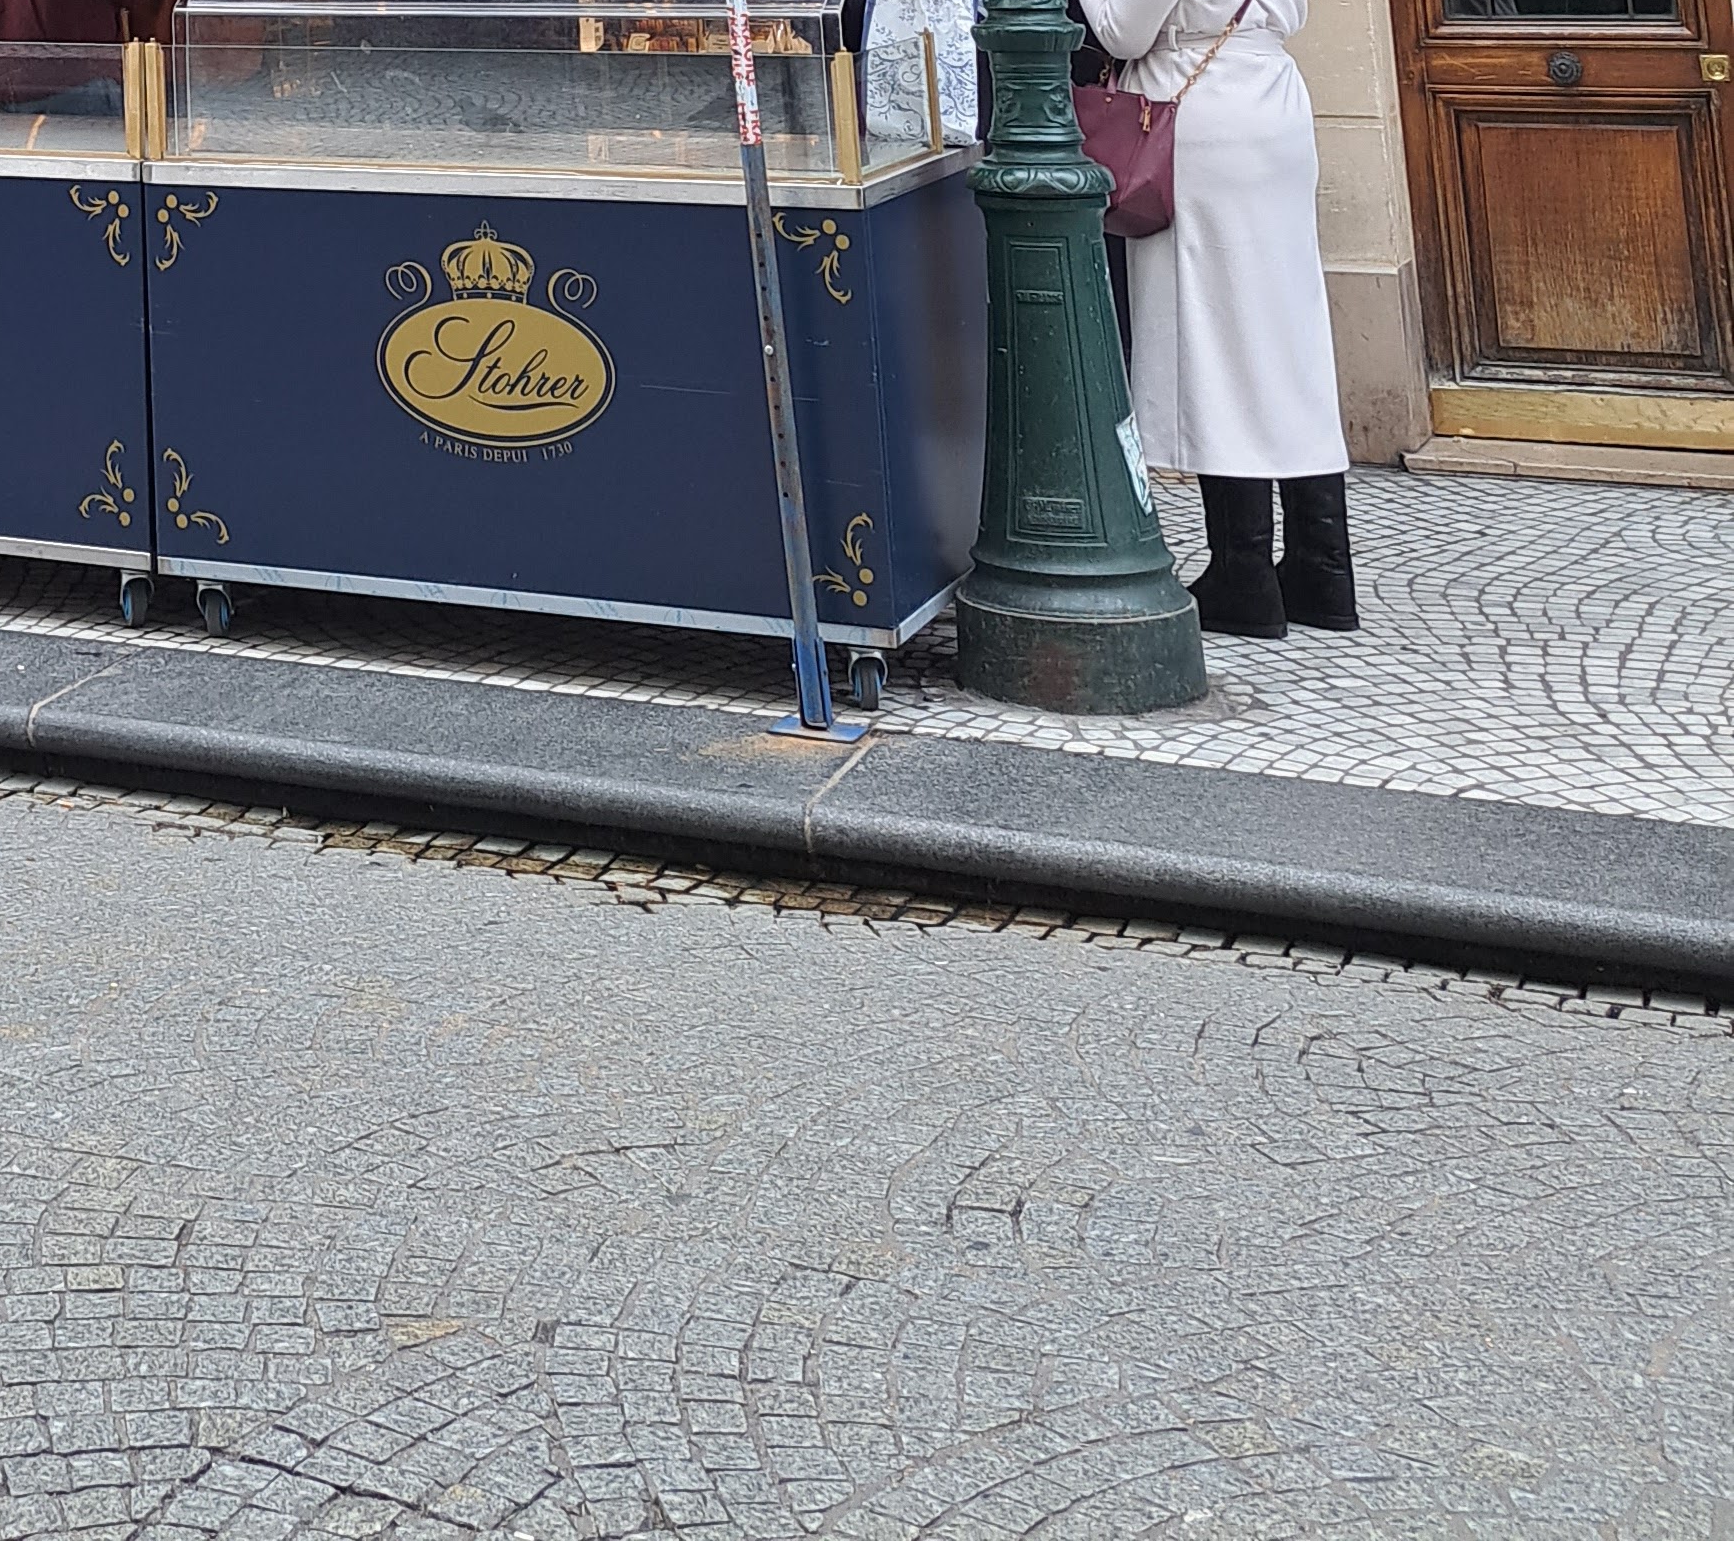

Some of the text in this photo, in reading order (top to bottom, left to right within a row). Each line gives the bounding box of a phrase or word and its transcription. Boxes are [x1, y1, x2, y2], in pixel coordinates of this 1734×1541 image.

[403, 315, 590, 405] Stohrer
[434, 435, 478, 460] PARIS
[483, 448, 528, 463] DEPUI
[541, 441, 573, 461] 1730
